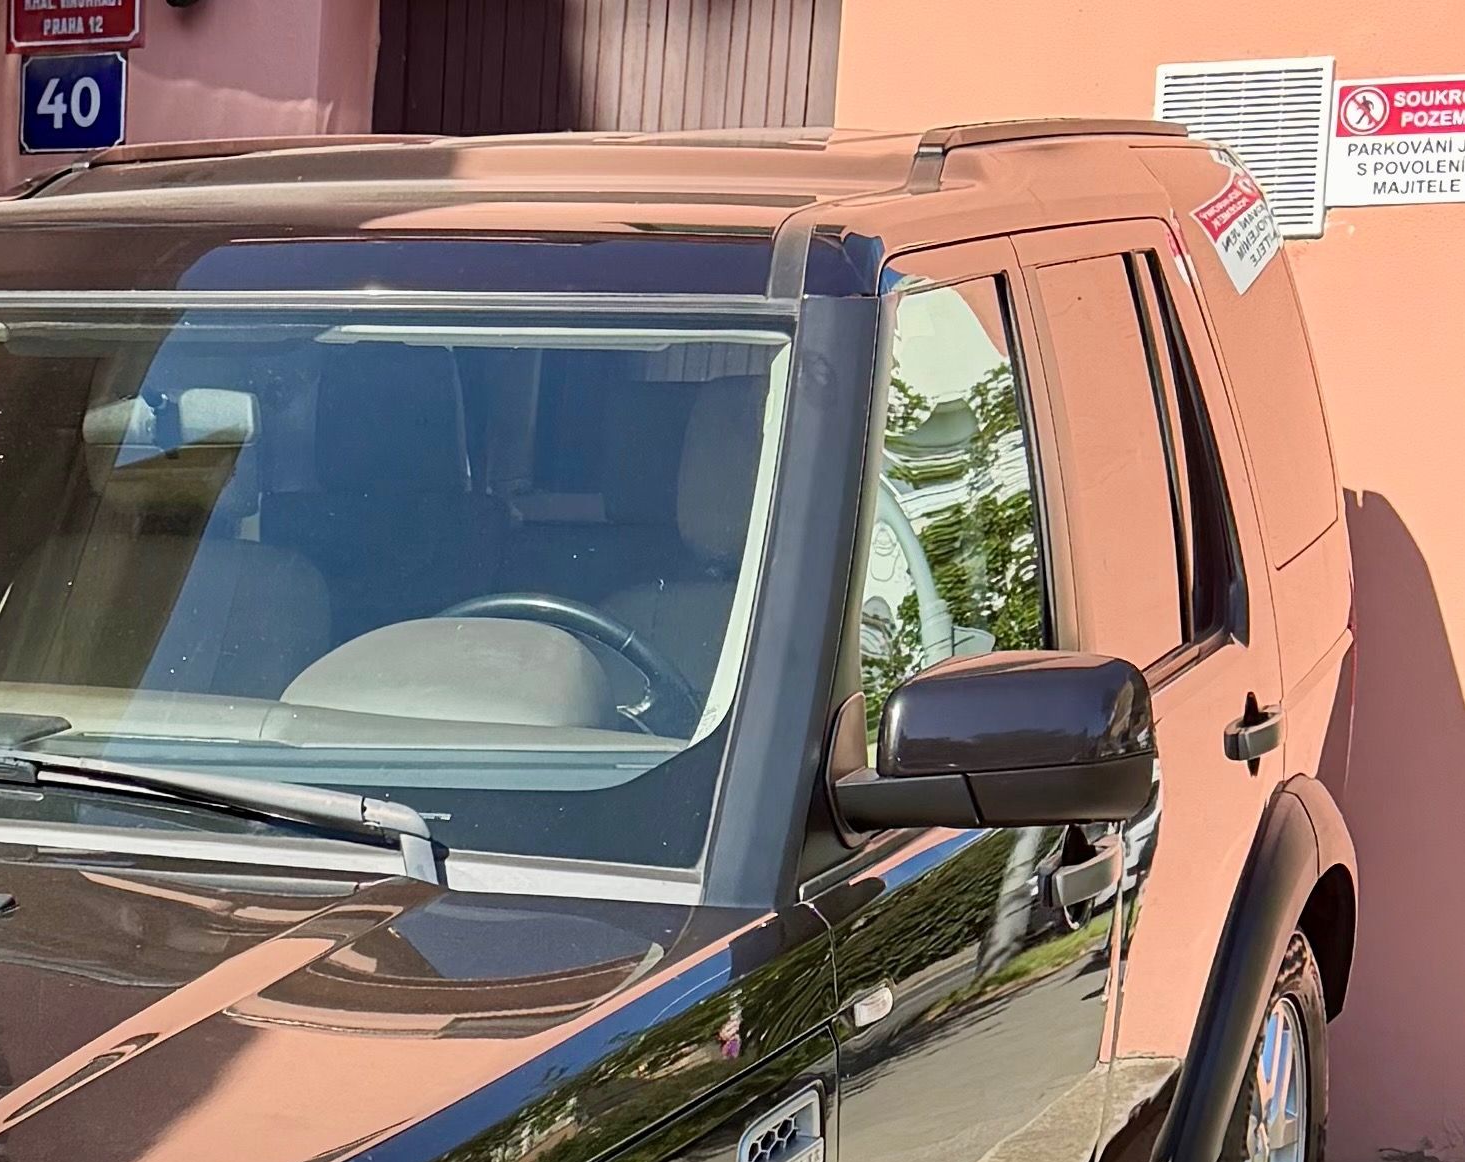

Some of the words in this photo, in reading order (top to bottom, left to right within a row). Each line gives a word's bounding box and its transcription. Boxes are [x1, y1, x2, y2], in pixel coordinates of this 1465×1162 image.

[43, 16, 84, 36] PRAHA
[88, 15, 104, 33] 12
[36, 76, 101, 129] 40
[1347, 137, 1453, 157] PARKOVÁNÍ
[1357, 162, 1367, 176] S
[1373, 178, 1461, 195] MAJITELE
